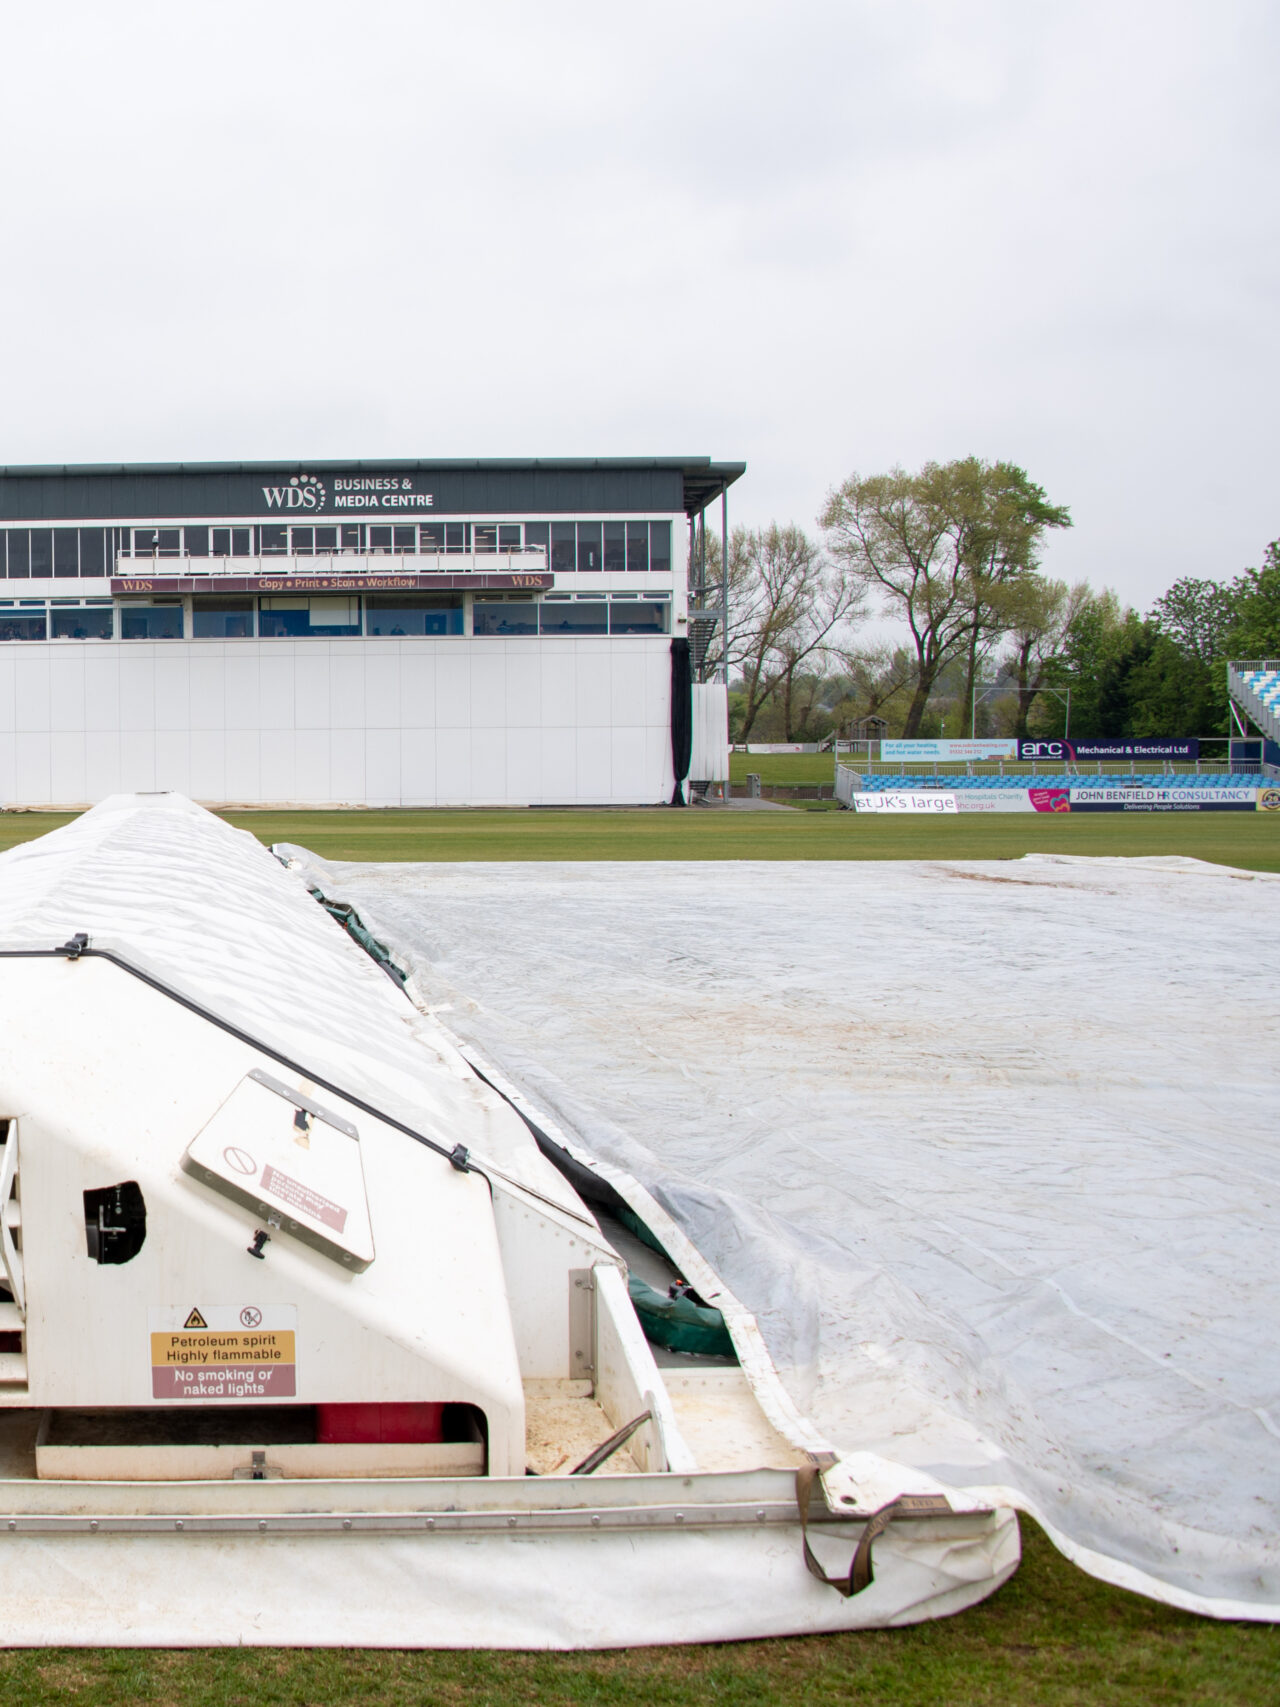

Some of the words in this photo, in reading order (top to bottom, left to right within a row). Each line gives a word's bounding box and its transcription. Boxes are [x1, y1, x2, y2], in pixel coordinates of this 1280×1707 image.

[334, 478, 399, 491] BUSINESS
[401, 478, 412, 490] &
[262, 487, 316, 508] WDS
[334, 495, 379, 507] MEDIA
[381, 495, 433, 507] CENTRE
[122, 580, 153, 591] WDS
[258, 579, 283, 590] Copy
[295, 578, 320, 588] Print
[331, 578, 355, 588] Scan
[366, 577, 416, 587] Workflow
[511, 575, 543, 586] WDS
[1022, 742, 1063, 755] arc
[1077, 746, 1124, 754] Mechanical
[1125, 746, 1132, 754] &
[1134, 746, 1172, 754] Electrical
[1174, 746, 1188, 754] Ltd
[965, 793, 997, 801] Hospitals
[998, 793, 1023, 801] Charity
[1076, 791, 1103, 800] JOHN
[1106, 790, 1154, 800] BENFIELD
[1157, 790, 1170, 800] HR
[1172, 790, 1250, 800] CONSULTANCY
[912, 796, 954, 811] large
[1124, 803, 1153, 811] Delivering
[1153, 803, 1172, 811] People
[171, 1336, 238, 1347] Petroleum
[243, 1335, 276, 1348] spirit
[167, 1350, 208, 1363] Highly
[213, 1349, 281, 1361] flammable
[175, 1370, 194, 1382] No
[198, 1369, 255, 1383] smoking
[258, 1370, 273, 1380] or
[183, 1383, 224, 1395] naked
[228, 1383, 265, 1397] lights
